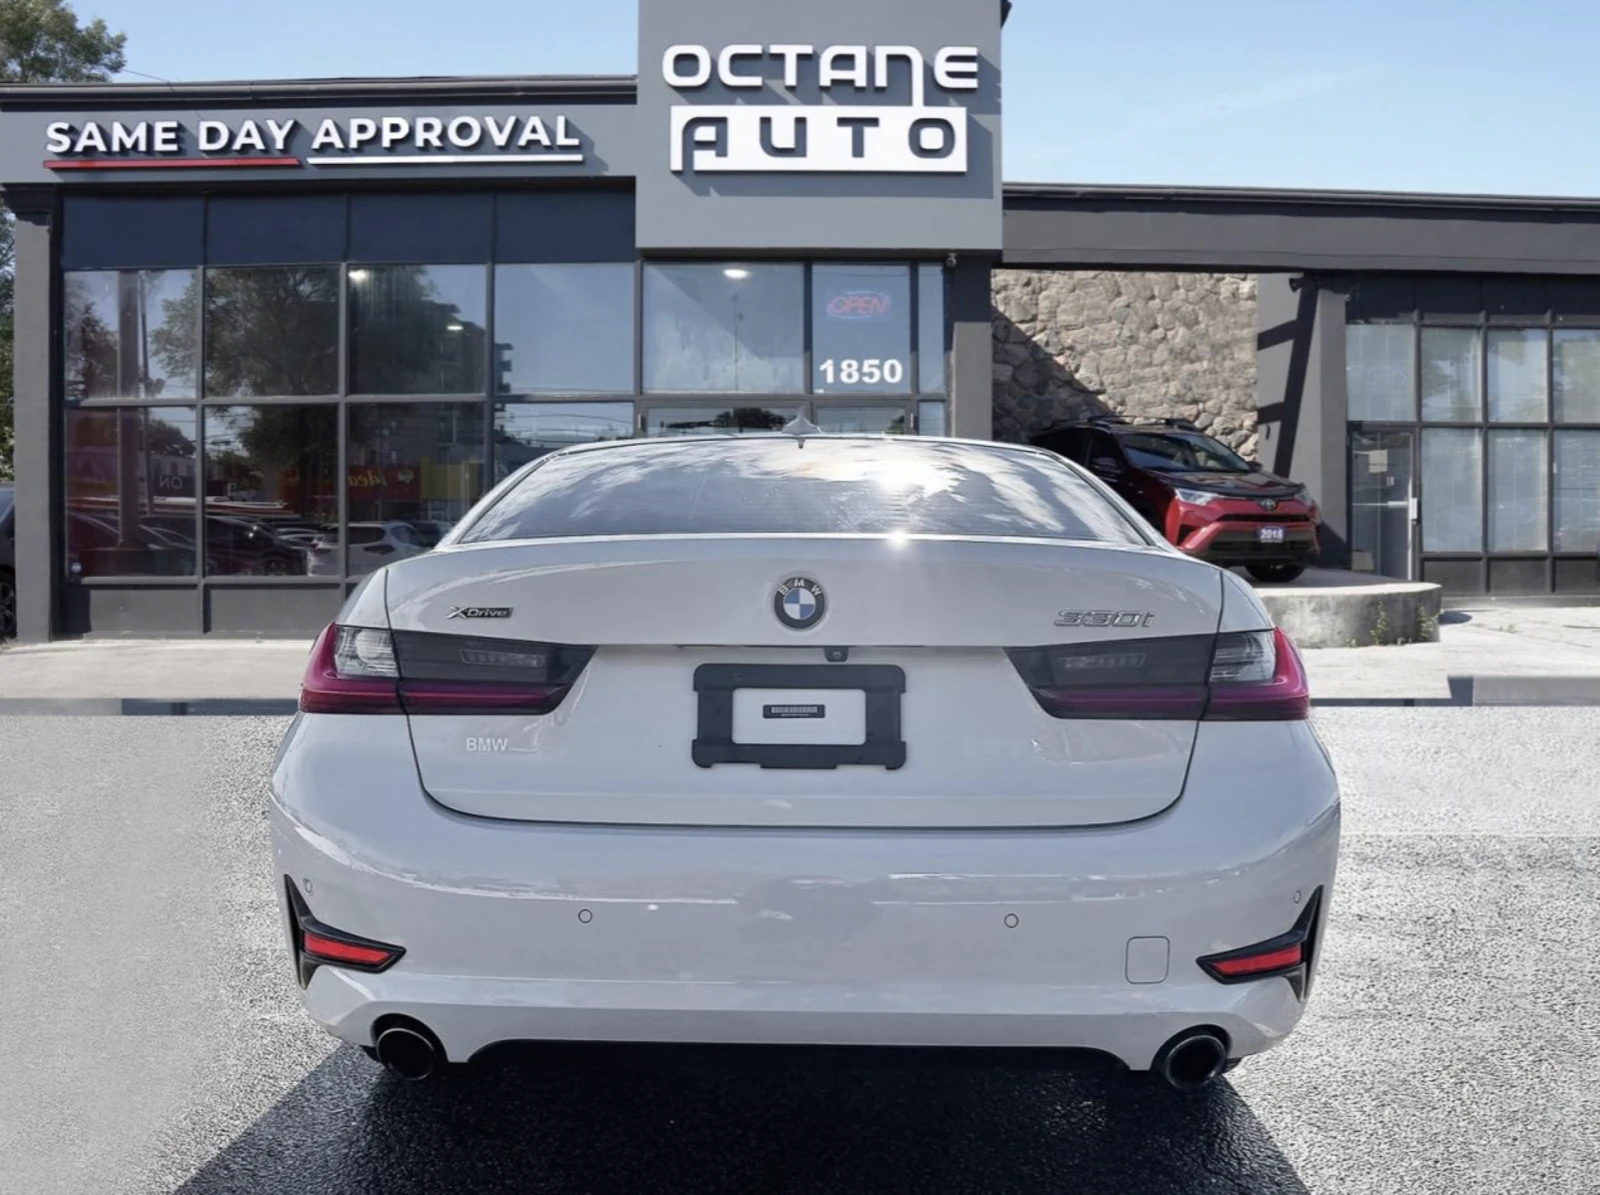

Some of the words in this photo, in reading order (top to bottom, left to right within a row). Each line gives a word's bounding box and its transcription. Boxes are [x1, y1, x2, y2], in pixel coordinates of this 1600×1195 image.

[662, 44, 978, 89] OCTANE
[45, 120, 179, 153] SAME
[199, 119, 295, 151] DAY
[310, 115, 580, 150] APPROVAL
[681, 116, 956, 170] AUTO
[829, 296, 886, 315] OPEN
[819, 358, 903, 384] 1850
[779, 578, 822, 596] BMW
[465, 737, 508, 752] BMW
